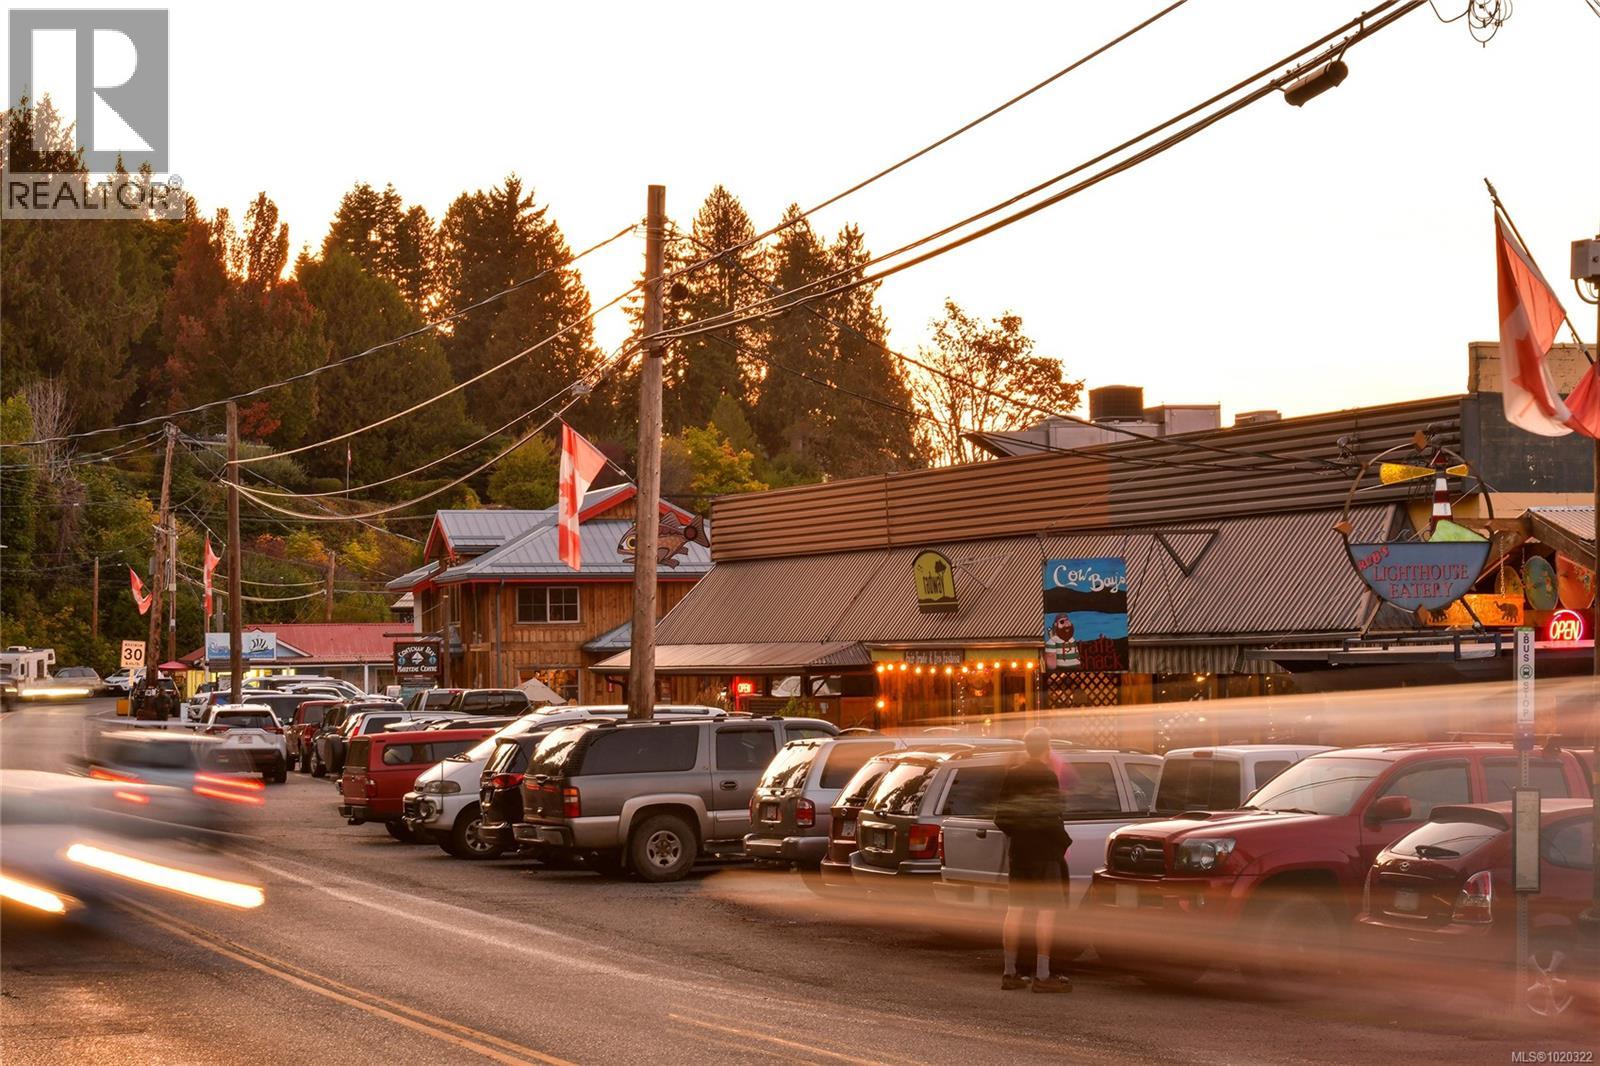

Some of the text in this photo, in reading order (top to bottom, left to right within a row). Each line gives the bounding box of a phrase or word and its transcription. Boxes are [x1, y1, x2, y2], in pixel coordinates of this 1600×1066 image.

[1053, 564, 1092, 588] Cow
[1373, 564, 1470, 581] LIGHTHOUSE
[1389, 582, 1454, 599] EATERY
[1550, 619, 1580, 641] OPEN
[124, 647, 143, 661] 30
